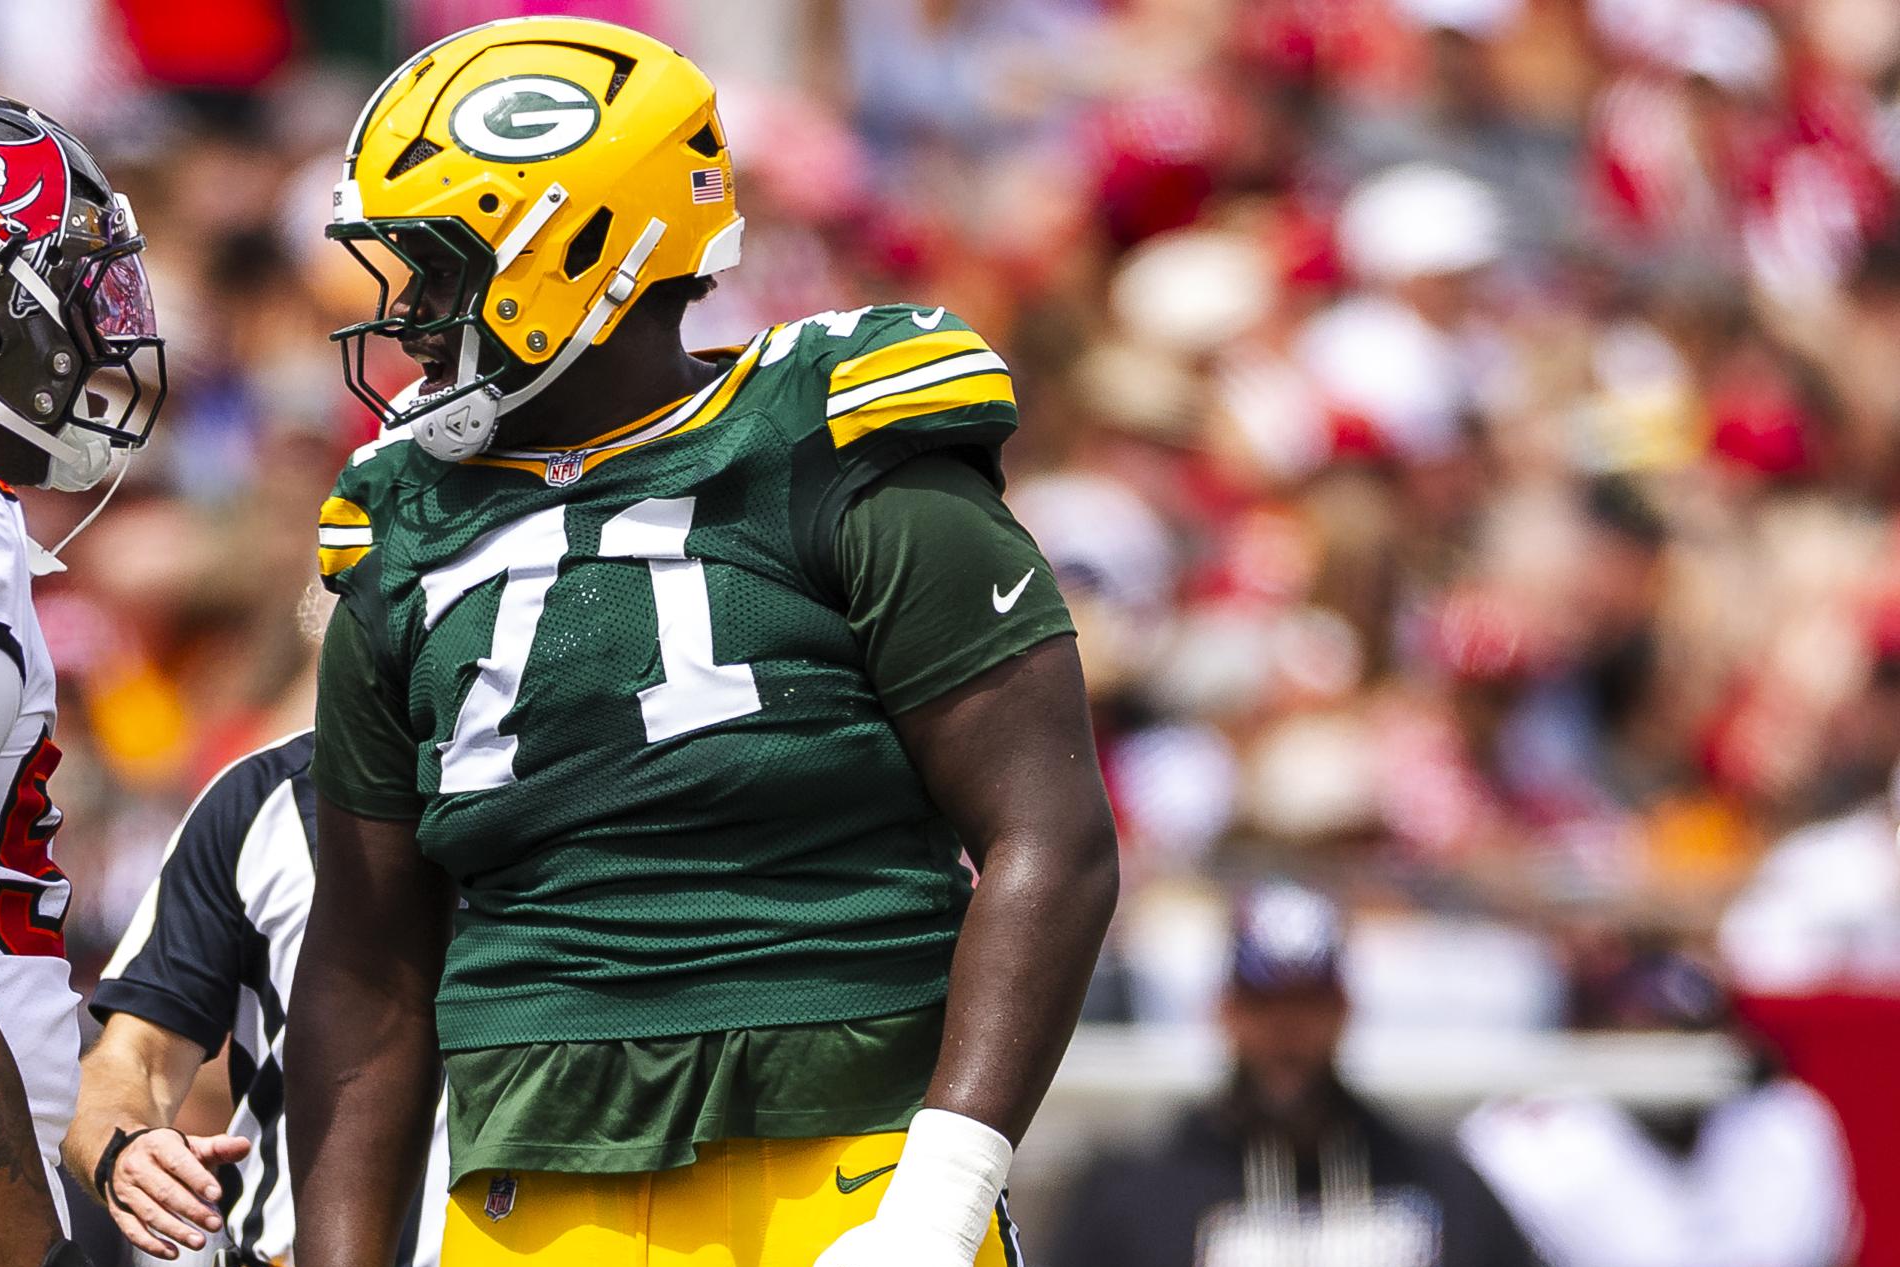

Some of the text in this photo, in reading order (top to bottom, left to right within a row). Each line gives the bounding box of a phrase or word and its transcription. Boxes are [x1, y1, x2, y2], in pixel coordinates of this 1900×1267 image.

[452, 77, 599, 160] G
[551, 463, 576, 481] NFL
[421, 497, 762, 795] 71
